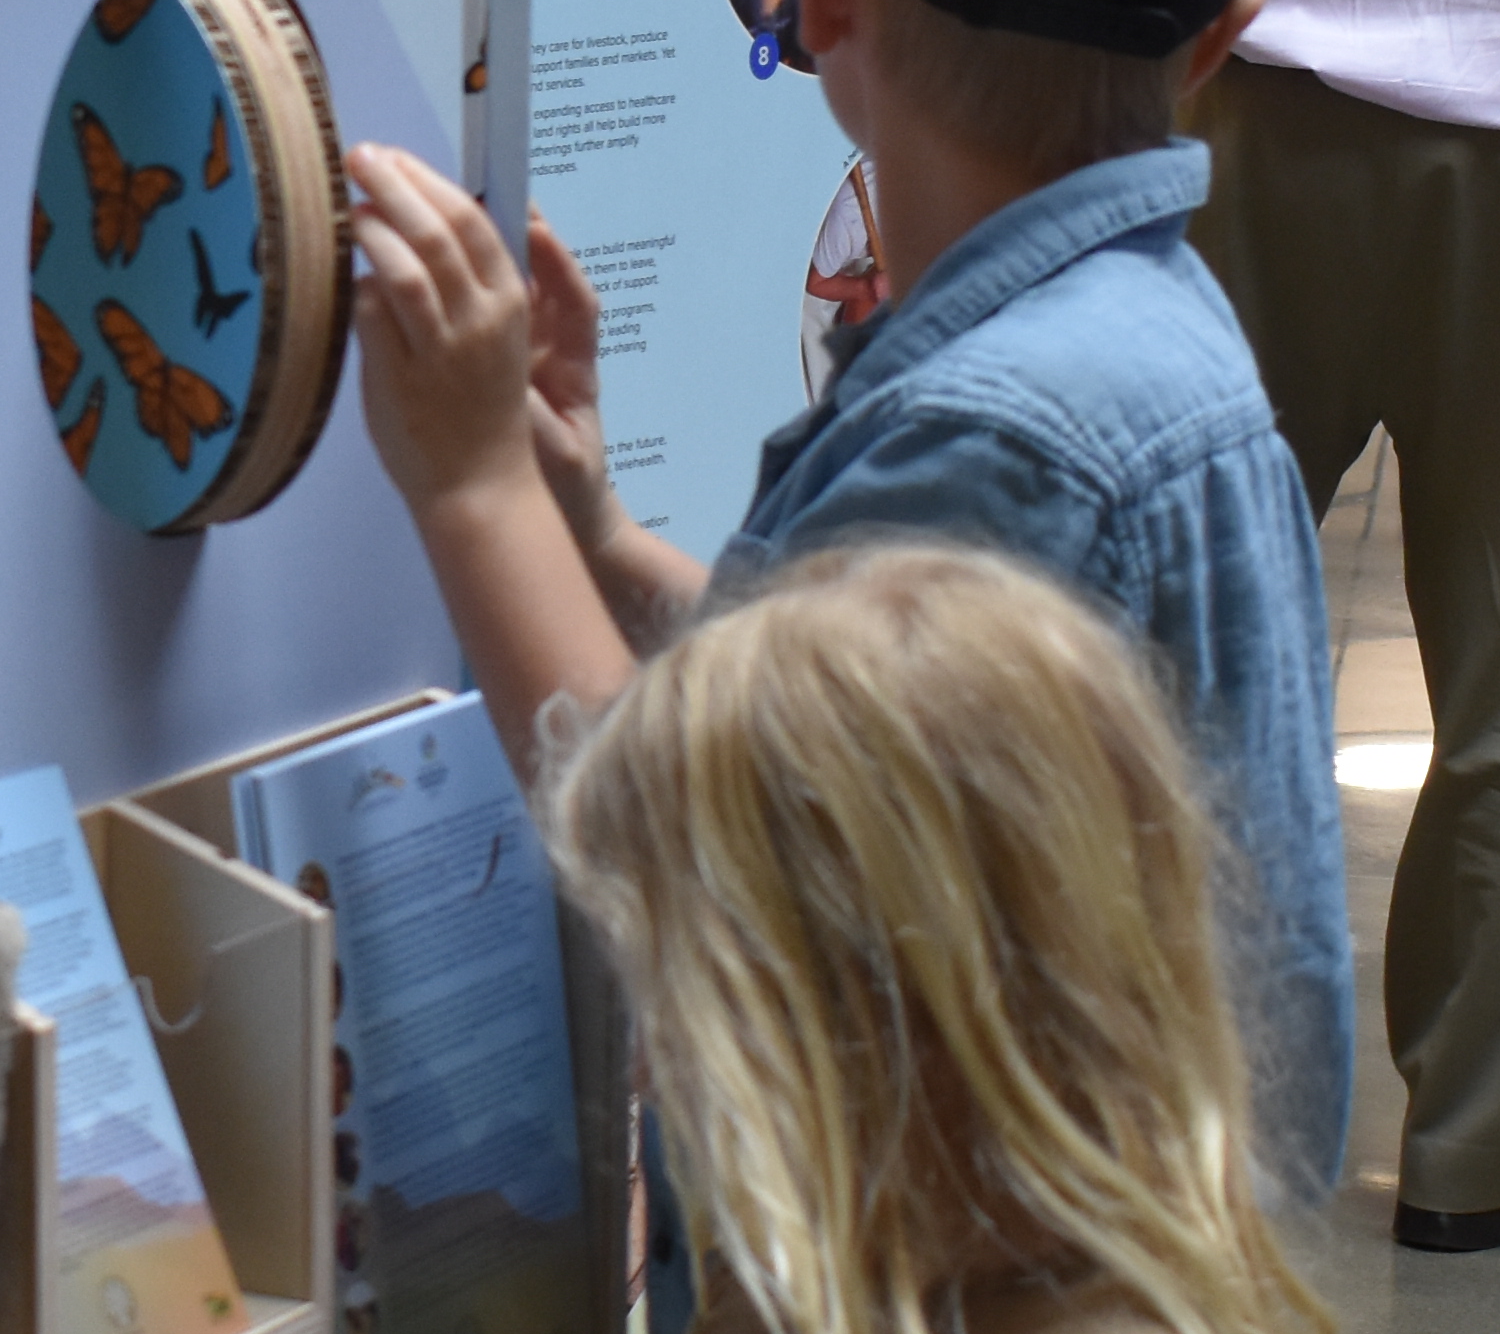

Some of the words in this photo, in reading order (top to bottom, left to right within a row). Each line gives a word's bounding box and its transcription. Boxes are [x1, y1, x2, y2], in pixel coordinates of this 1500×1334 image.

[550, 42, 568, 52] care
[572, 38, 584, 49] for
[631, 31, 668, 45] produce
[758, 46, 769, 65] 8
[534, 105, 581, 120] expanding
[584, 101, 615, 114] access
[617, 99, 627, 109] to
[629, 95, 675, 108] healthcare
